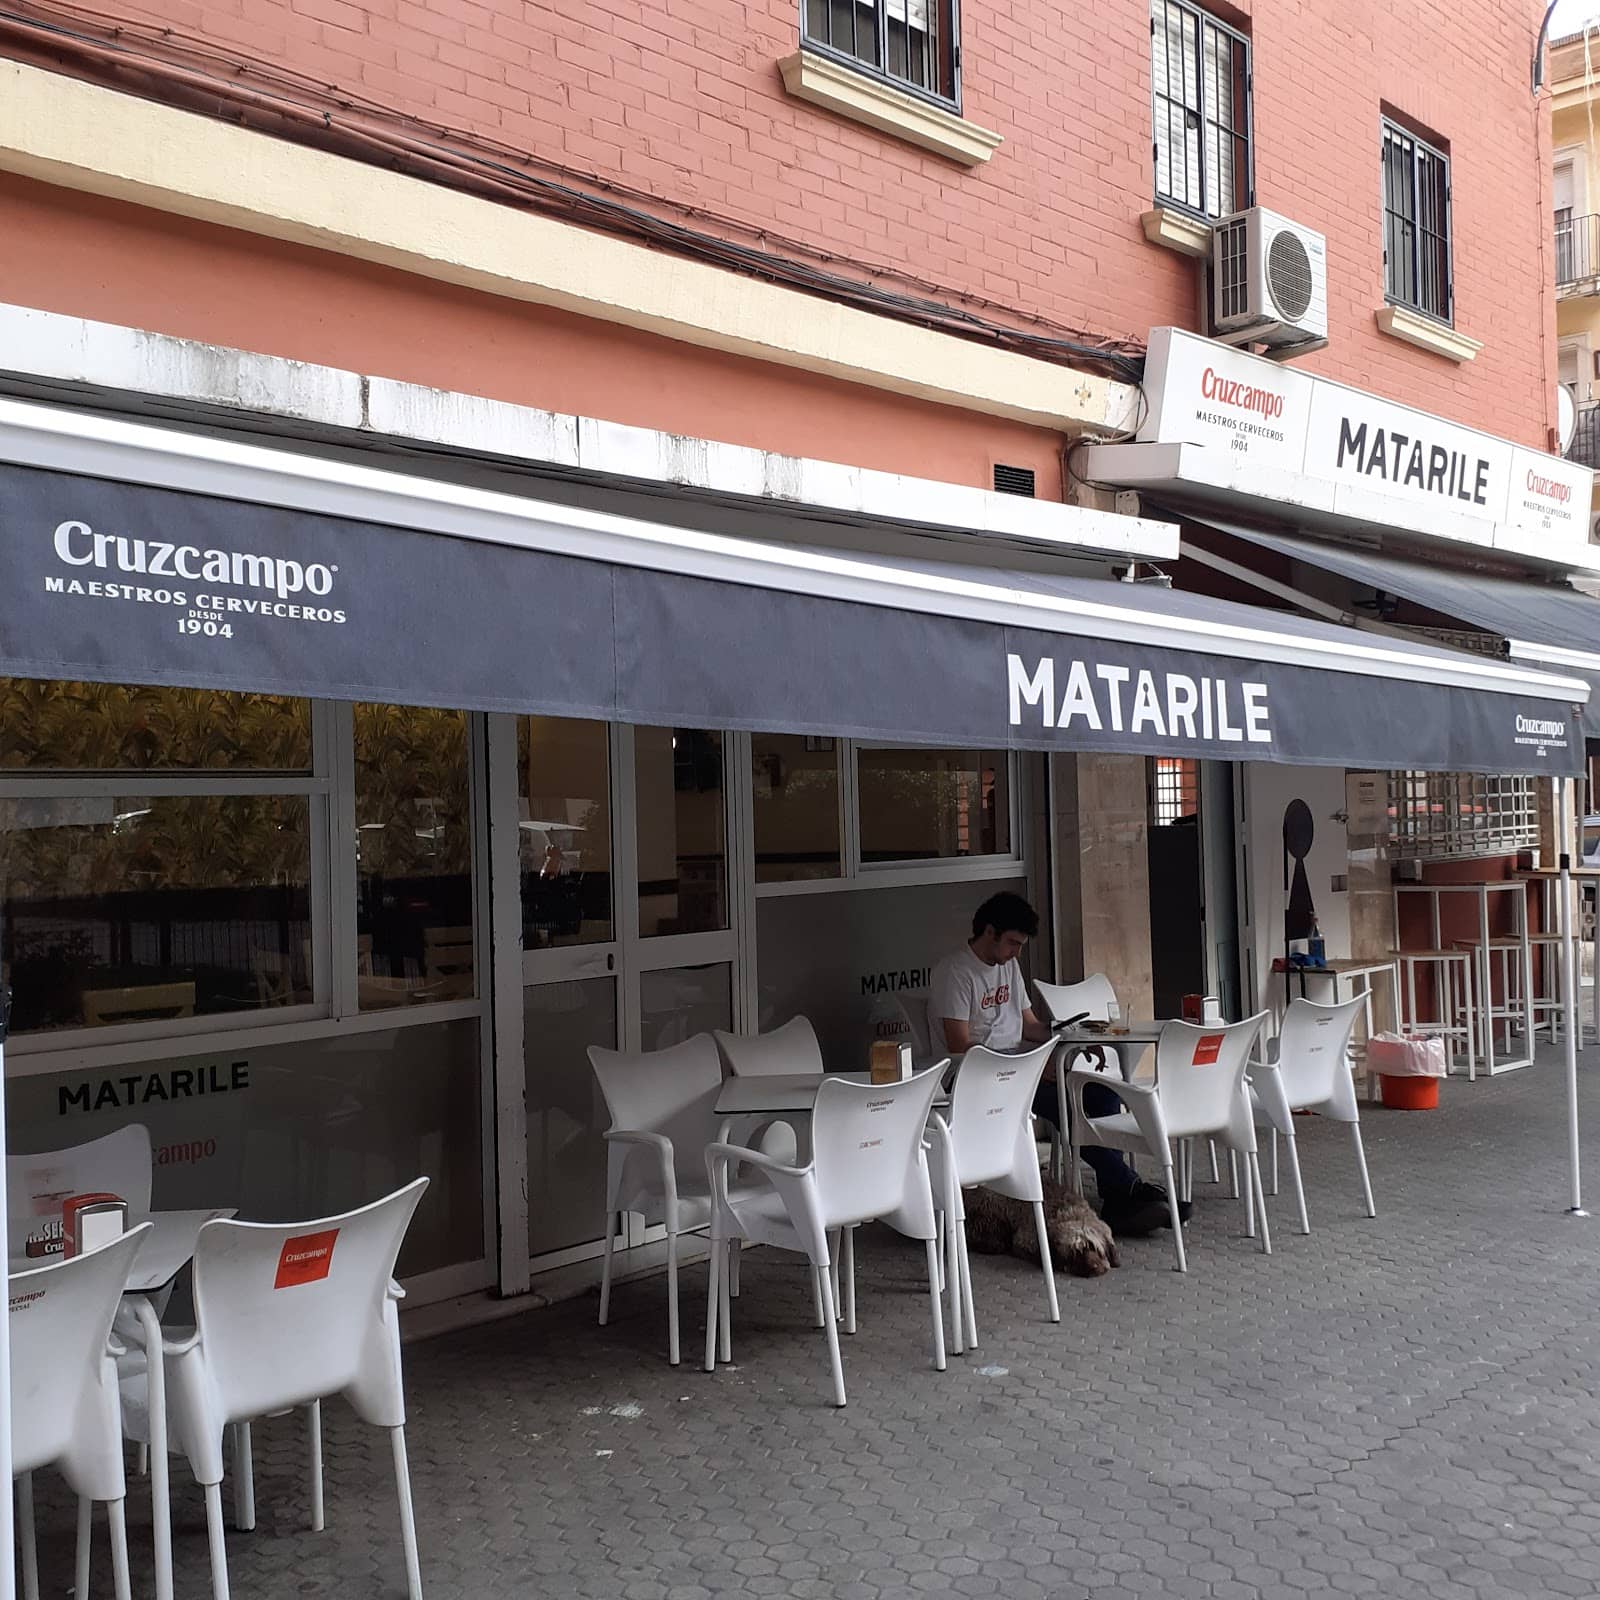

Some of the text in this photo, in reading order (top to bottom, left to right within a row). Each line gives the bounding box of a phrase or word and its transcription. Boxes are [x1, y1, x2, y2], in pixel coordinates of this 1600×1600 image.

[1201, 367, 1284, 421] Cruzcampo
[1196, 410, 1237, 430] MAESTROS
[1239, 421, 1284, 442] CERVECEROS
[1231, 439, 1248, 453] 1904
[1336, 416, 1490, 506] MATARILE
[1526, 468, 1572, 506] Cruzcampo
[53, 520, 336, 600] Cruzcampo
[44, 575, 347, 624] MAESTROS CERVECEROS
[188, 609, 224, 622] DESDE
[176, 618, 234, 640] 1904
[1007, 653, 1273, 743] MATARILE
[1515, 713, 1565, 739] Cruzcampo
[58, 1060, 250, 1116] MATARILE
